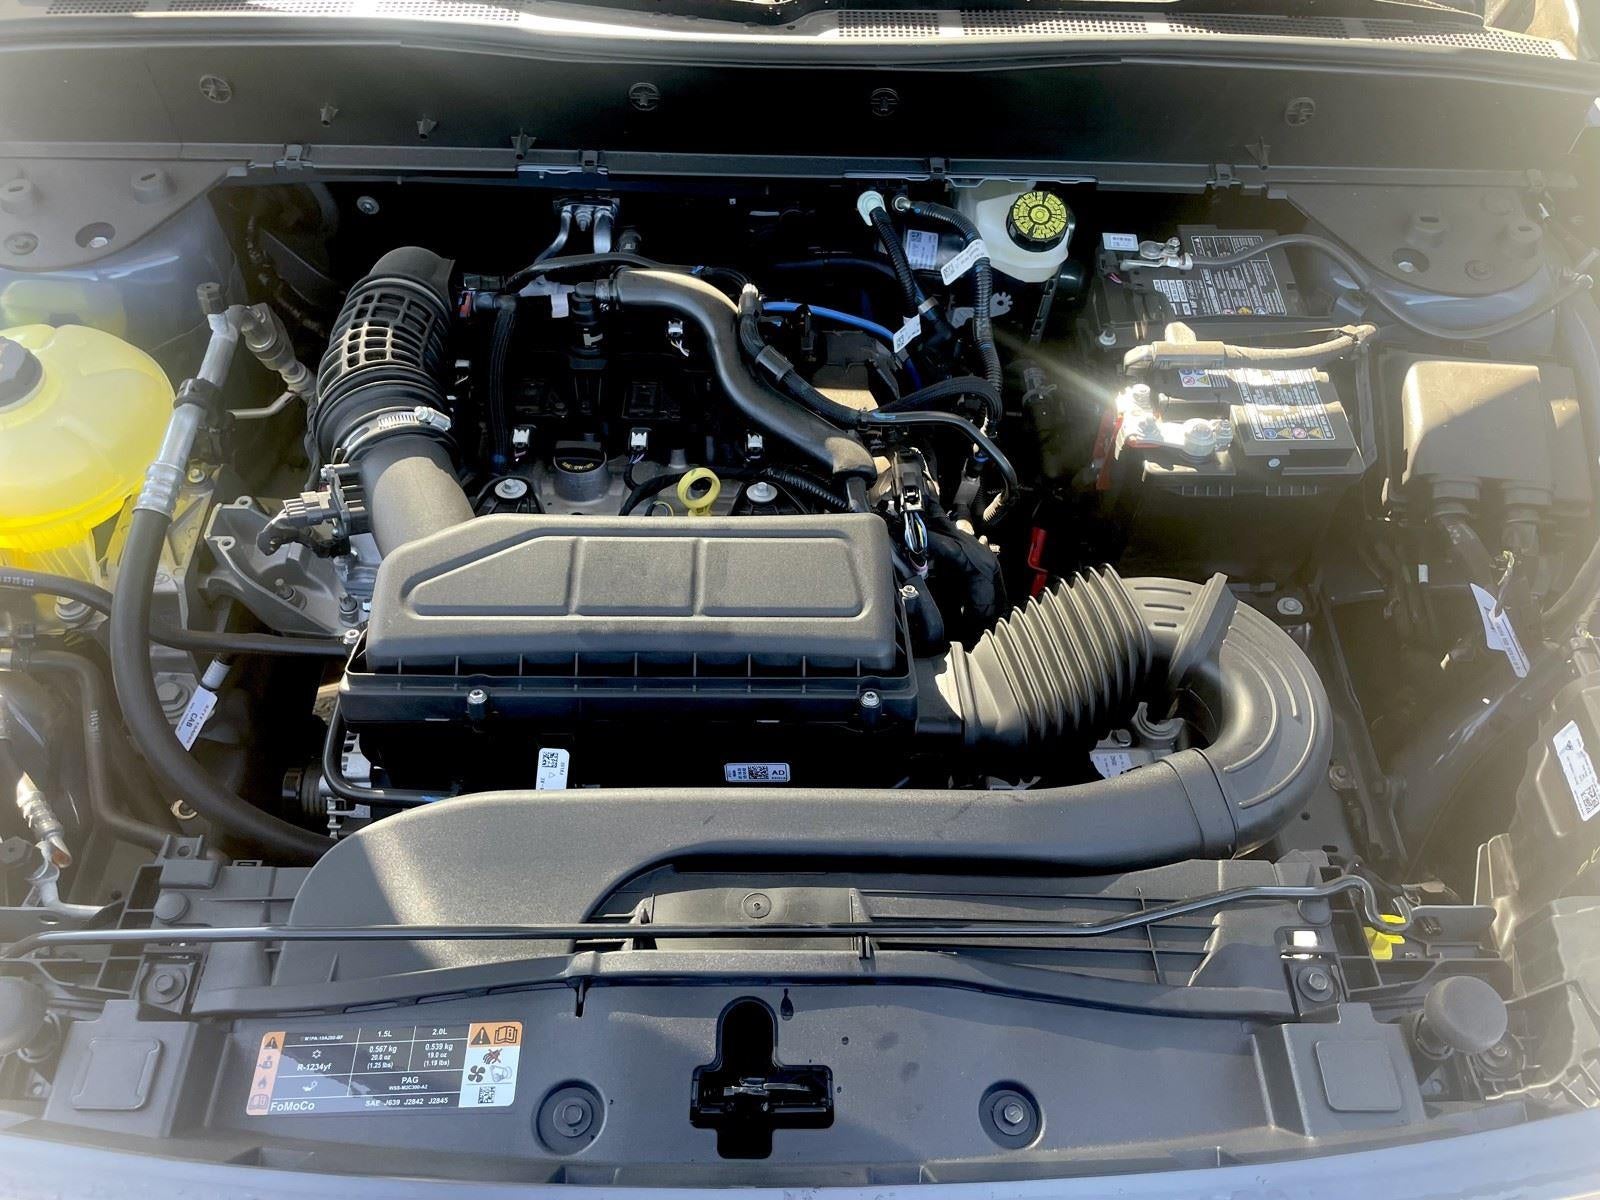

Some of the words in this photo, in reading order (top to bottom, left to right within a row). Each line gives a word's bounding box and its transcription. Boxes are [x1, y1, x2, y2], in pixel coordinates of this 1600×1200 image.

[186, 712, 198, 728] CAB
[377, 1030, 393, 1038] 1.5L
[432, 1027, 448, 1036] 2.0L
[369, 1045, 387, 1053] 0.567
[388, 1045, 398, 1054] kg
[424, 1043, 444, 1051] 0.539
[444, 1043, 454, 1051] kg
[296, 1063, 332, 1072] R-1234yf
[401, 1076, 419, 1084] PAG
[403, 1098, 424, 1106] J2842
[428, 1097, 449, 1105] J2845
[270, 1101, 316, 1112] FoMoCo
